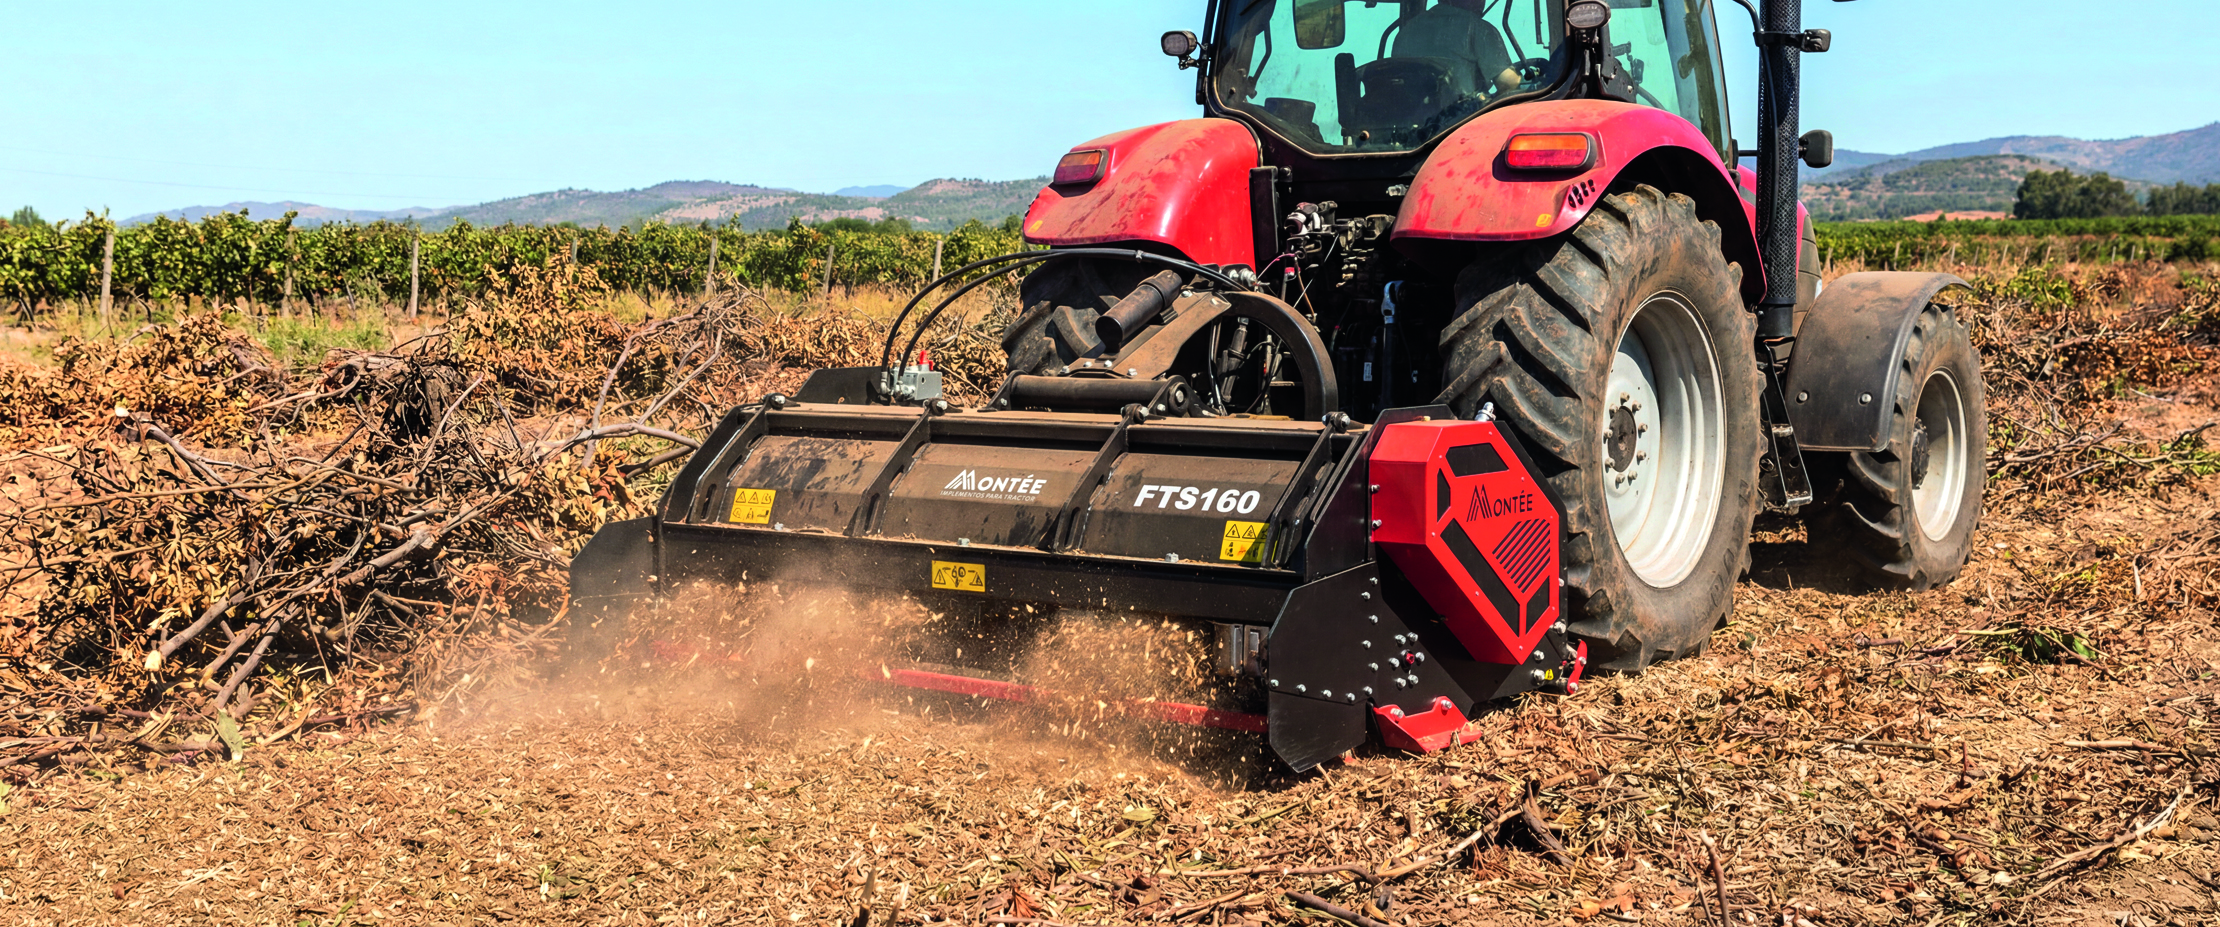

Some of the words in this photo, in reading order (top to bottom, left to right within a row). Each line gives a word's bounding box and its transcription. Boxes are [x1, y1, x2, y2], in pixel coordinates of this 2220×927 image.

[940, 490, 985, 499] IMPLEMENTOS
[1003, 494, 1036, 502] TRACTOR
[1133, 484, 1260, 514] FTS160
